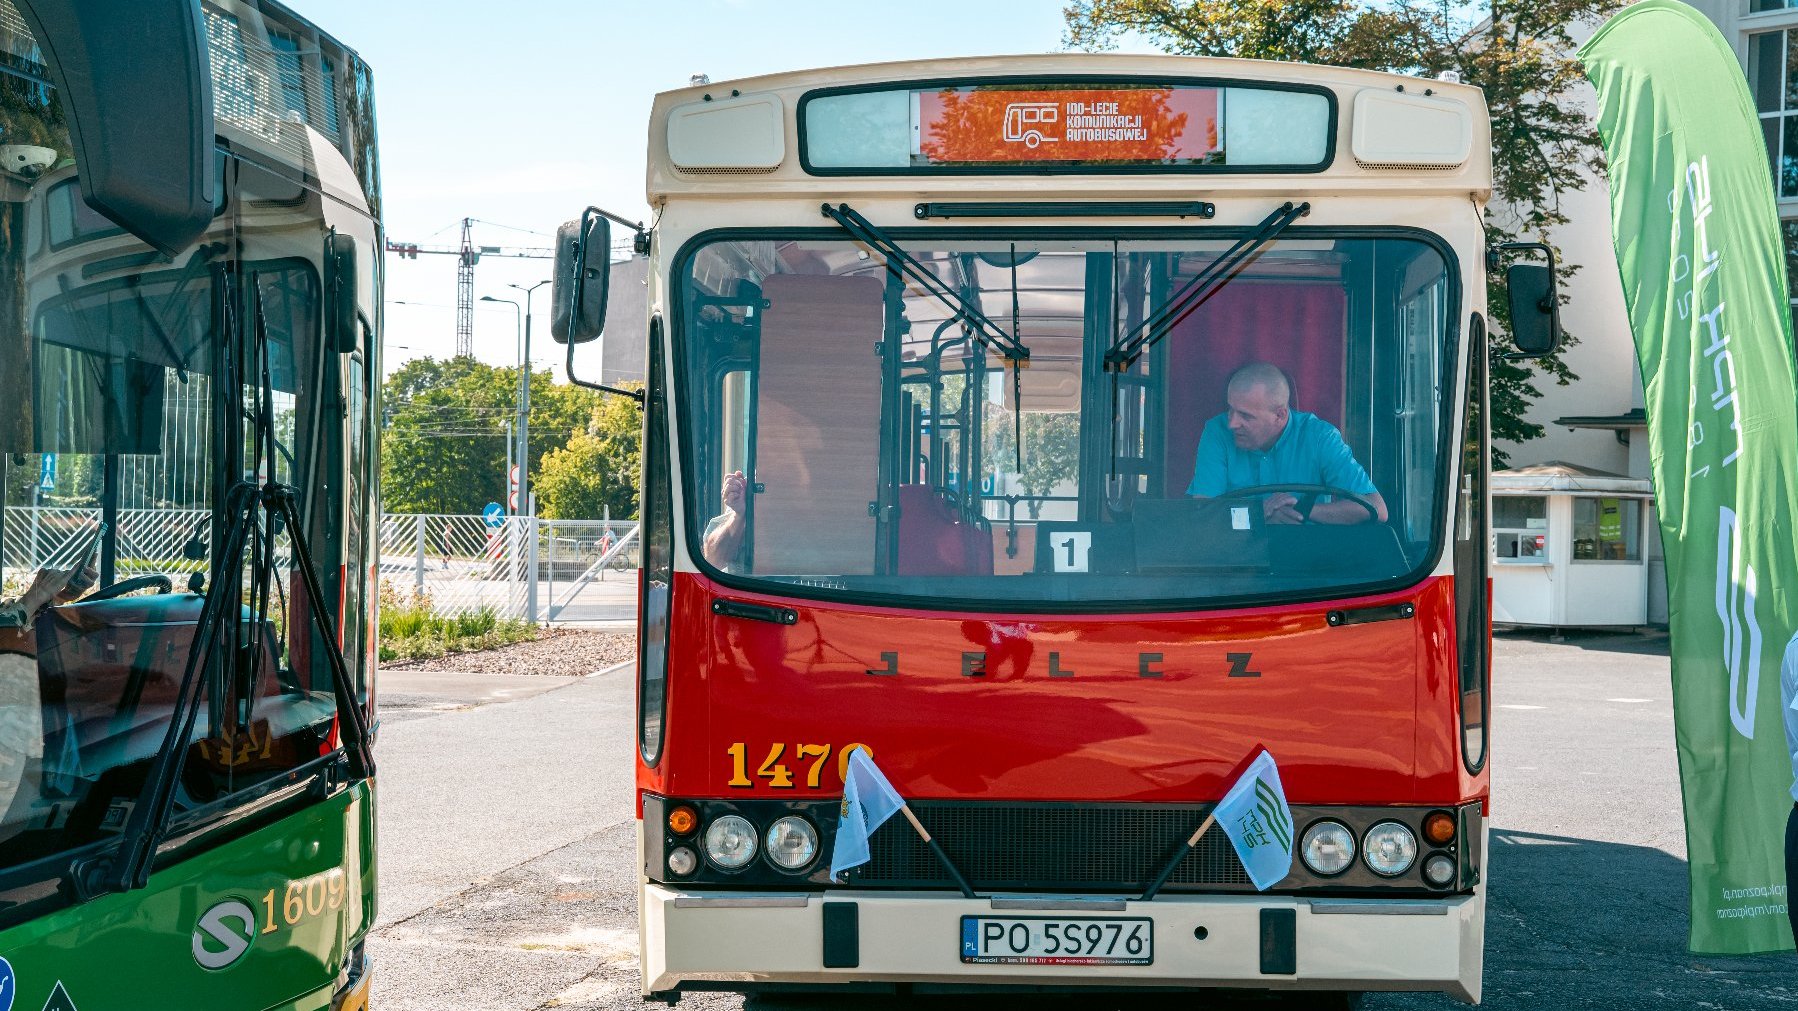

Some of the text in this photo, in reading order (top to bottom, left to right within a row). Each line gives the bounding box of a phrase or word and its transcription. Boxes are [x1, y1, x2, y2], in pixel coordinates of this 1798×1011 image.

[1066, 102, 1119, 115] 100-LECIE
[1066, 115, 1142, 128] KOMUNIKACJI
[1066, 128, 1147, 142] AUTOBUSOWEJ
[1061, 537, 1075, 567] 1
[865, 651, 1262, 678] JELCZ
[262, 867, 345, 934] 1609
[965, 942, 977, 951] PL
[983, 922, 1144, 955] PO 5S976
